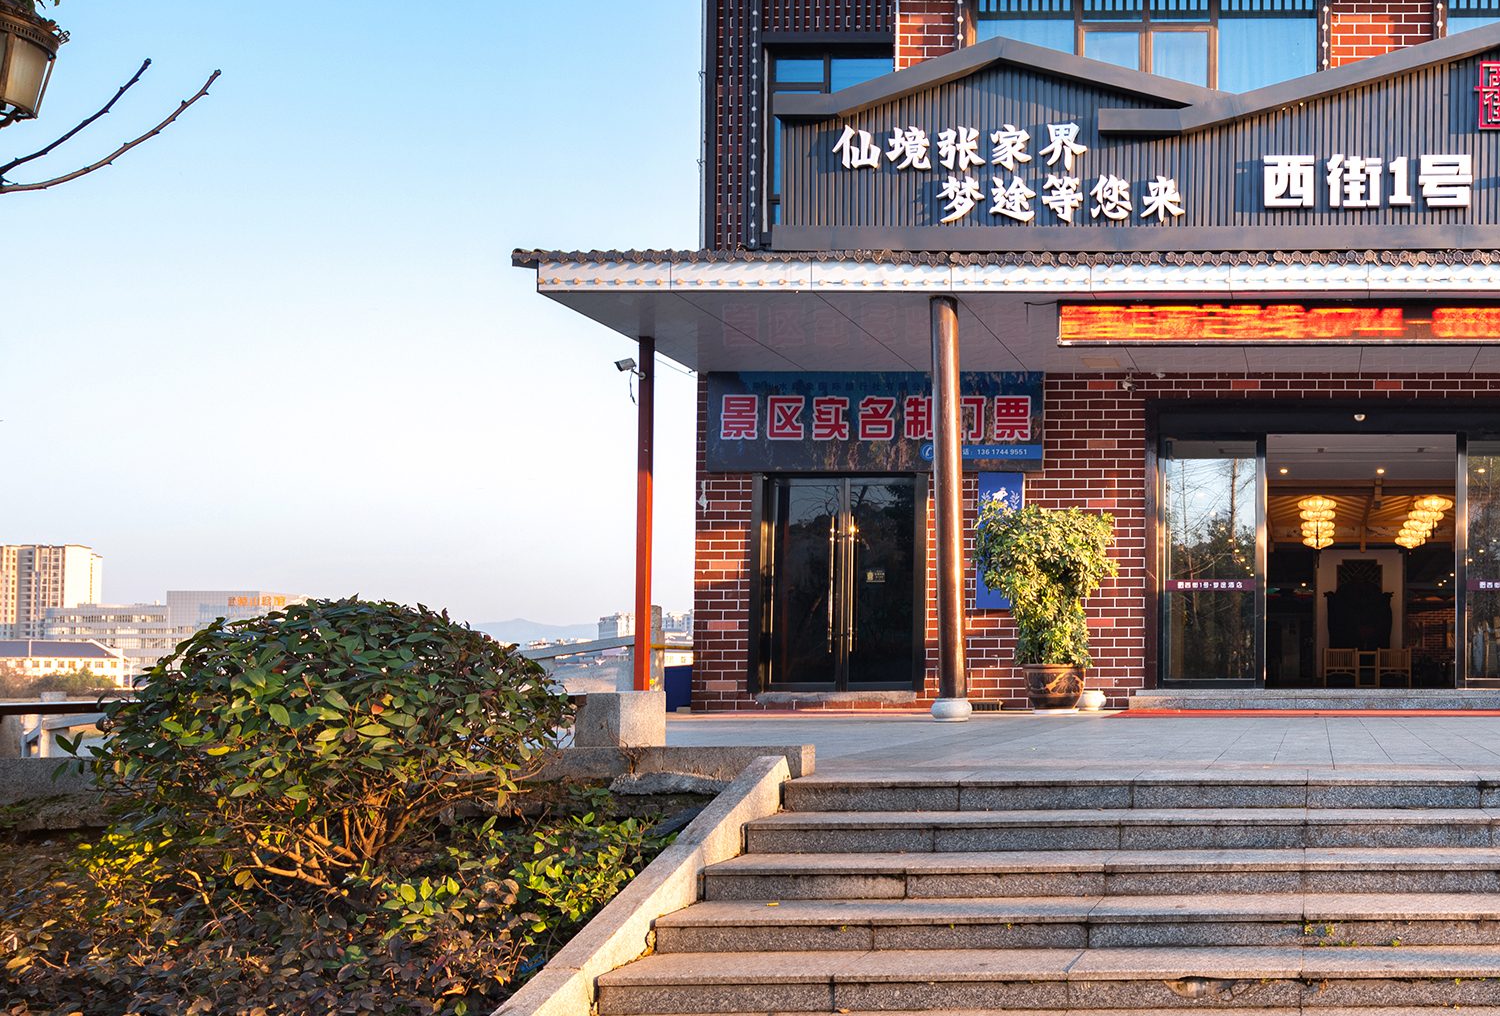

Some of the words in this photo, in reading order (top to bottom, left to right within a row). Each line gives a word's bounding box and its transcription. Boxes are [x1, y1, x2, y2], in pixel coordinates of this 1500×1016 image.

[832, 122, 1088, 171] 仙境张家界
[937, 174, 1185, 223] 梦途等您来
